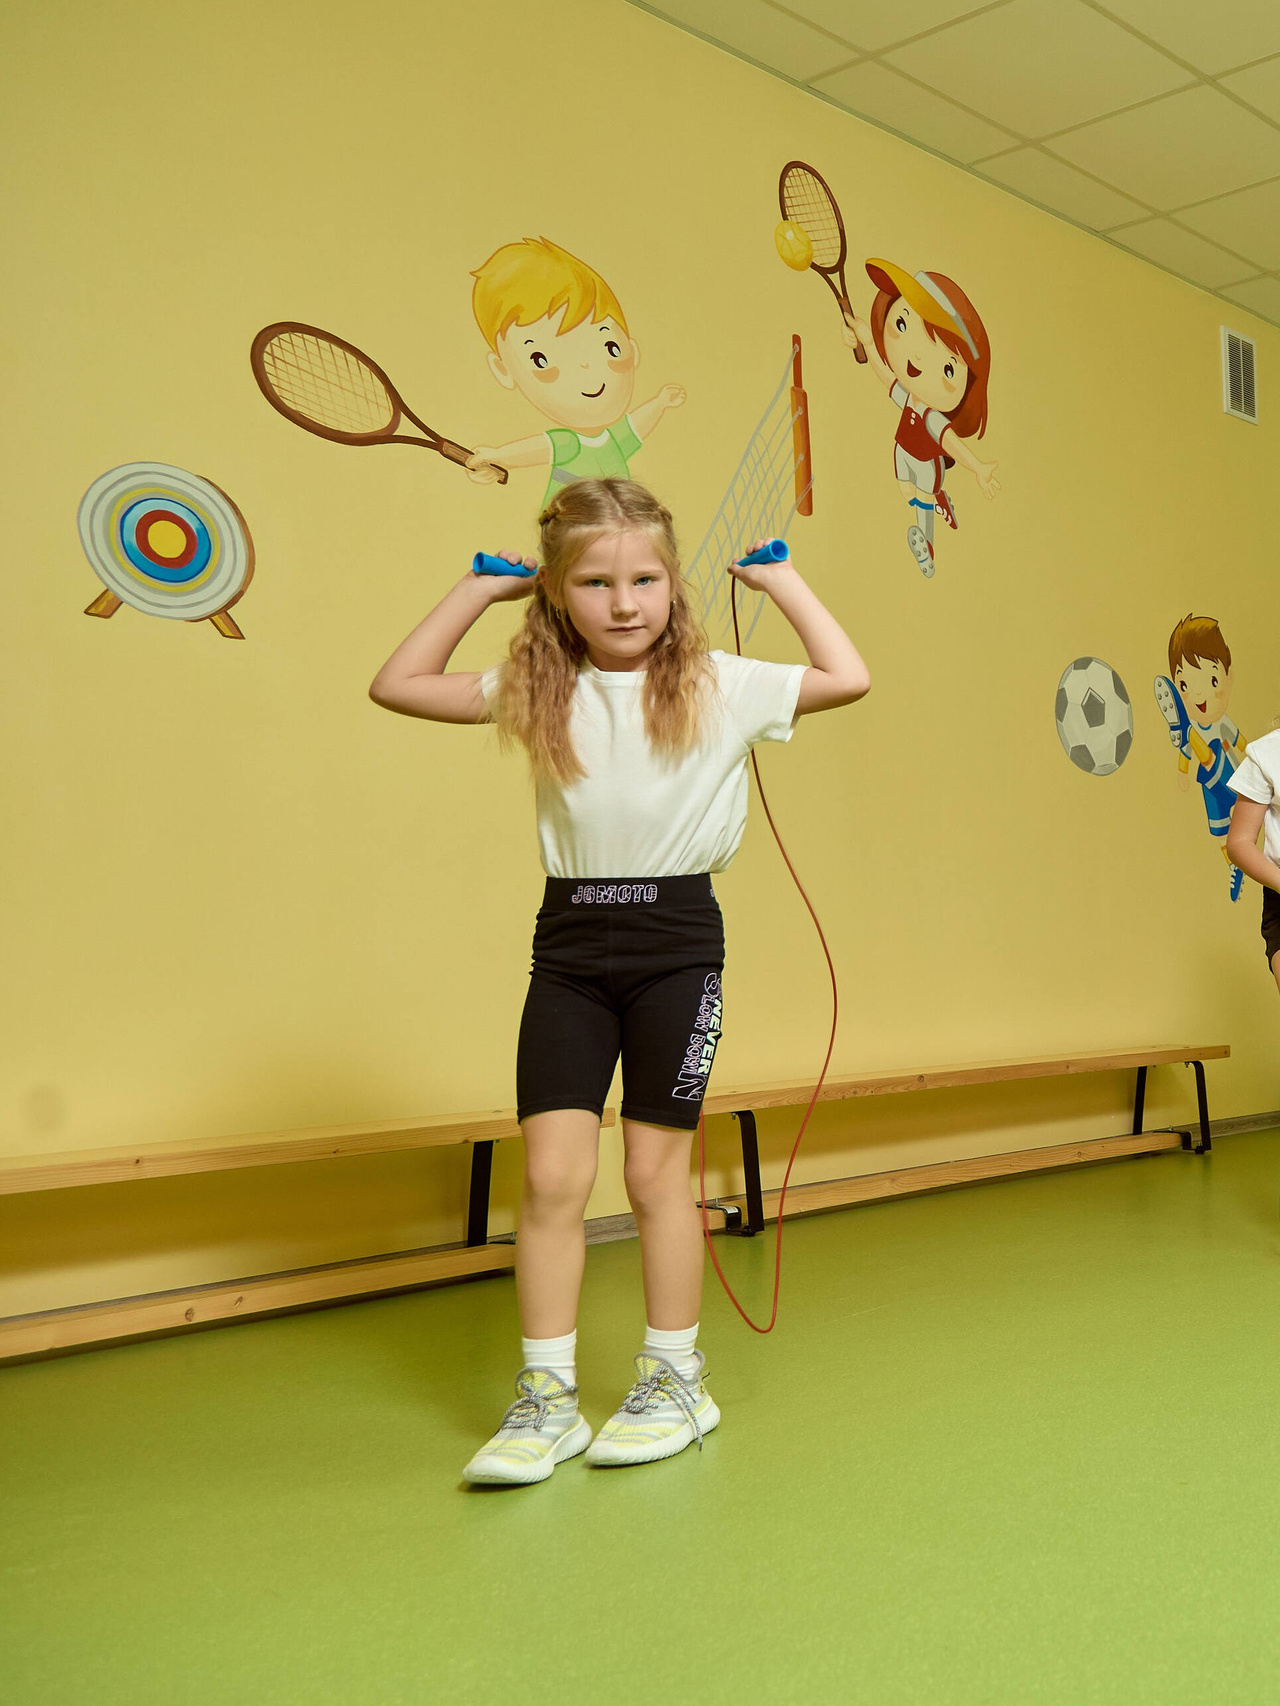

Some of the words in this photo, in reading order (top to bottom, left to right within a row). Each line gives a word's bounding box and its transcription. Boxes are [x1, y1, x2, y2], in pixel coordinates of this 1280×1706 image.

[571, 884, 656, 904] JOMOTO
[695, 972, 722, 1032] SLOW
[672, 1033, 708, 1101] DOWN
[698, 998, 723, 1075] NEVER
